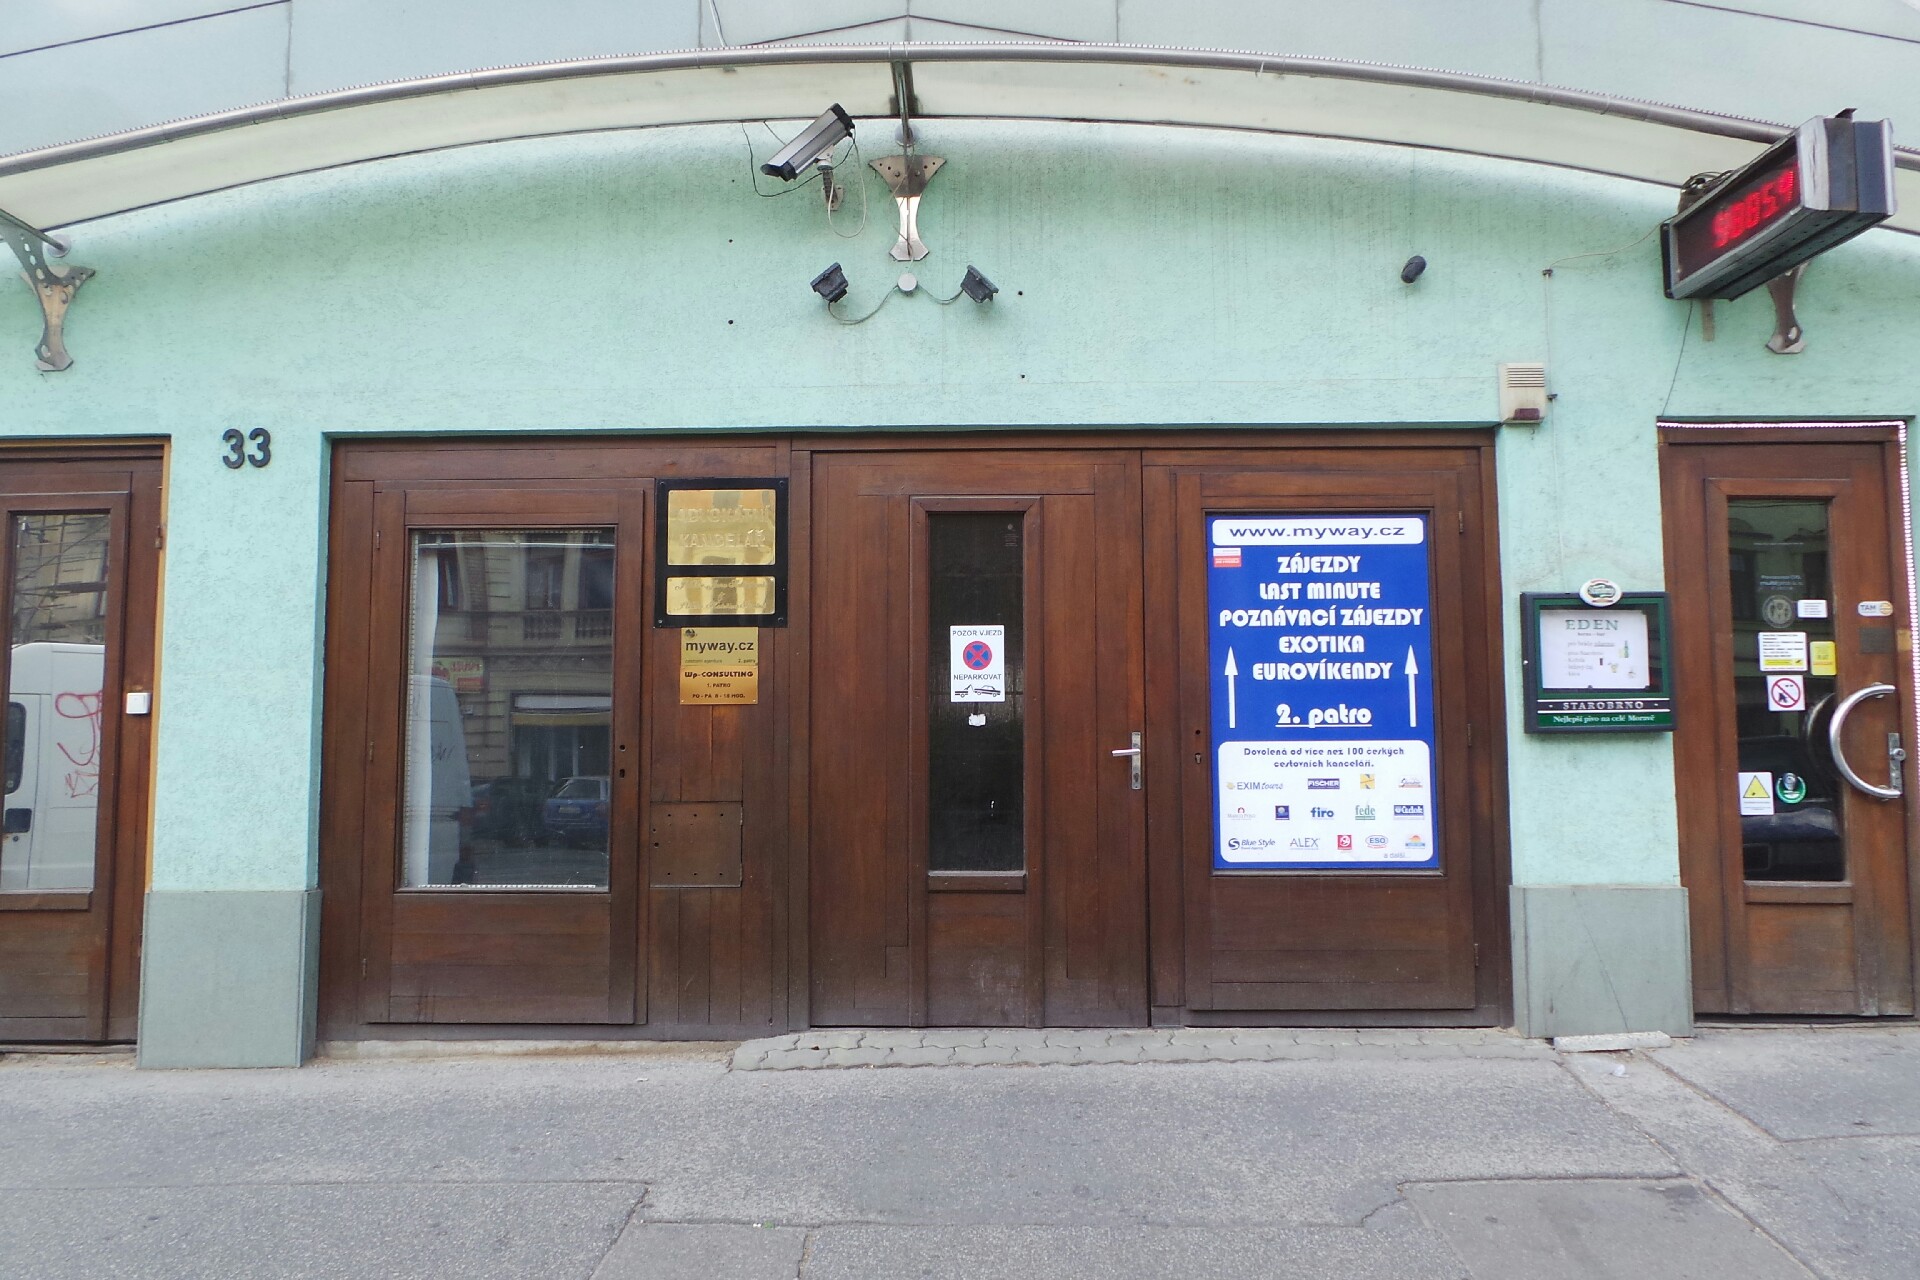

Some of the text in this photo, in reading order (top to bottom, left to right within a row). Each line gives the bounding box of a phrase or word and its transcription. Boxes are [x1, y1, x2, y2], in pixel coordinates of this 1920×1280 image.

[223, 428, 271, 469] 33
[1229, 525, 1405, 540] www.myway.cz
[1277, 552, 1361, 574] ZÁJEZDY
[1259, 582, 1381, 600] LAST MINUTE
[1220, 605, 1424, 627] POZNÁVACÍ ZÁJEZDY
[1565, 619, 1619, 631] EDEN
[686, 642, 754, 653] myway.cz
[1278, 635, 1365, 653] EXOTIKA
[1252, 658, 1393, 681] EUROVÍKENDY
[1563, 701, 1644, 710] STAROBRNO
[1275, 703, 1373, 728] 2. patro
[1553, 716, 1583, 724] Nejlepší
[1244, 747, 1287, 756] Dovolená
[1290, 747, 1302, 756] od
[1347, 747, 1364, 755] 100
[1308, 779, 1340, 787] FISCHER
[1310, 806, 1335, 818] firo
[1241, 838, 1276, 848] Blue Style
[1289, 838, 1319, 847] ALEX
